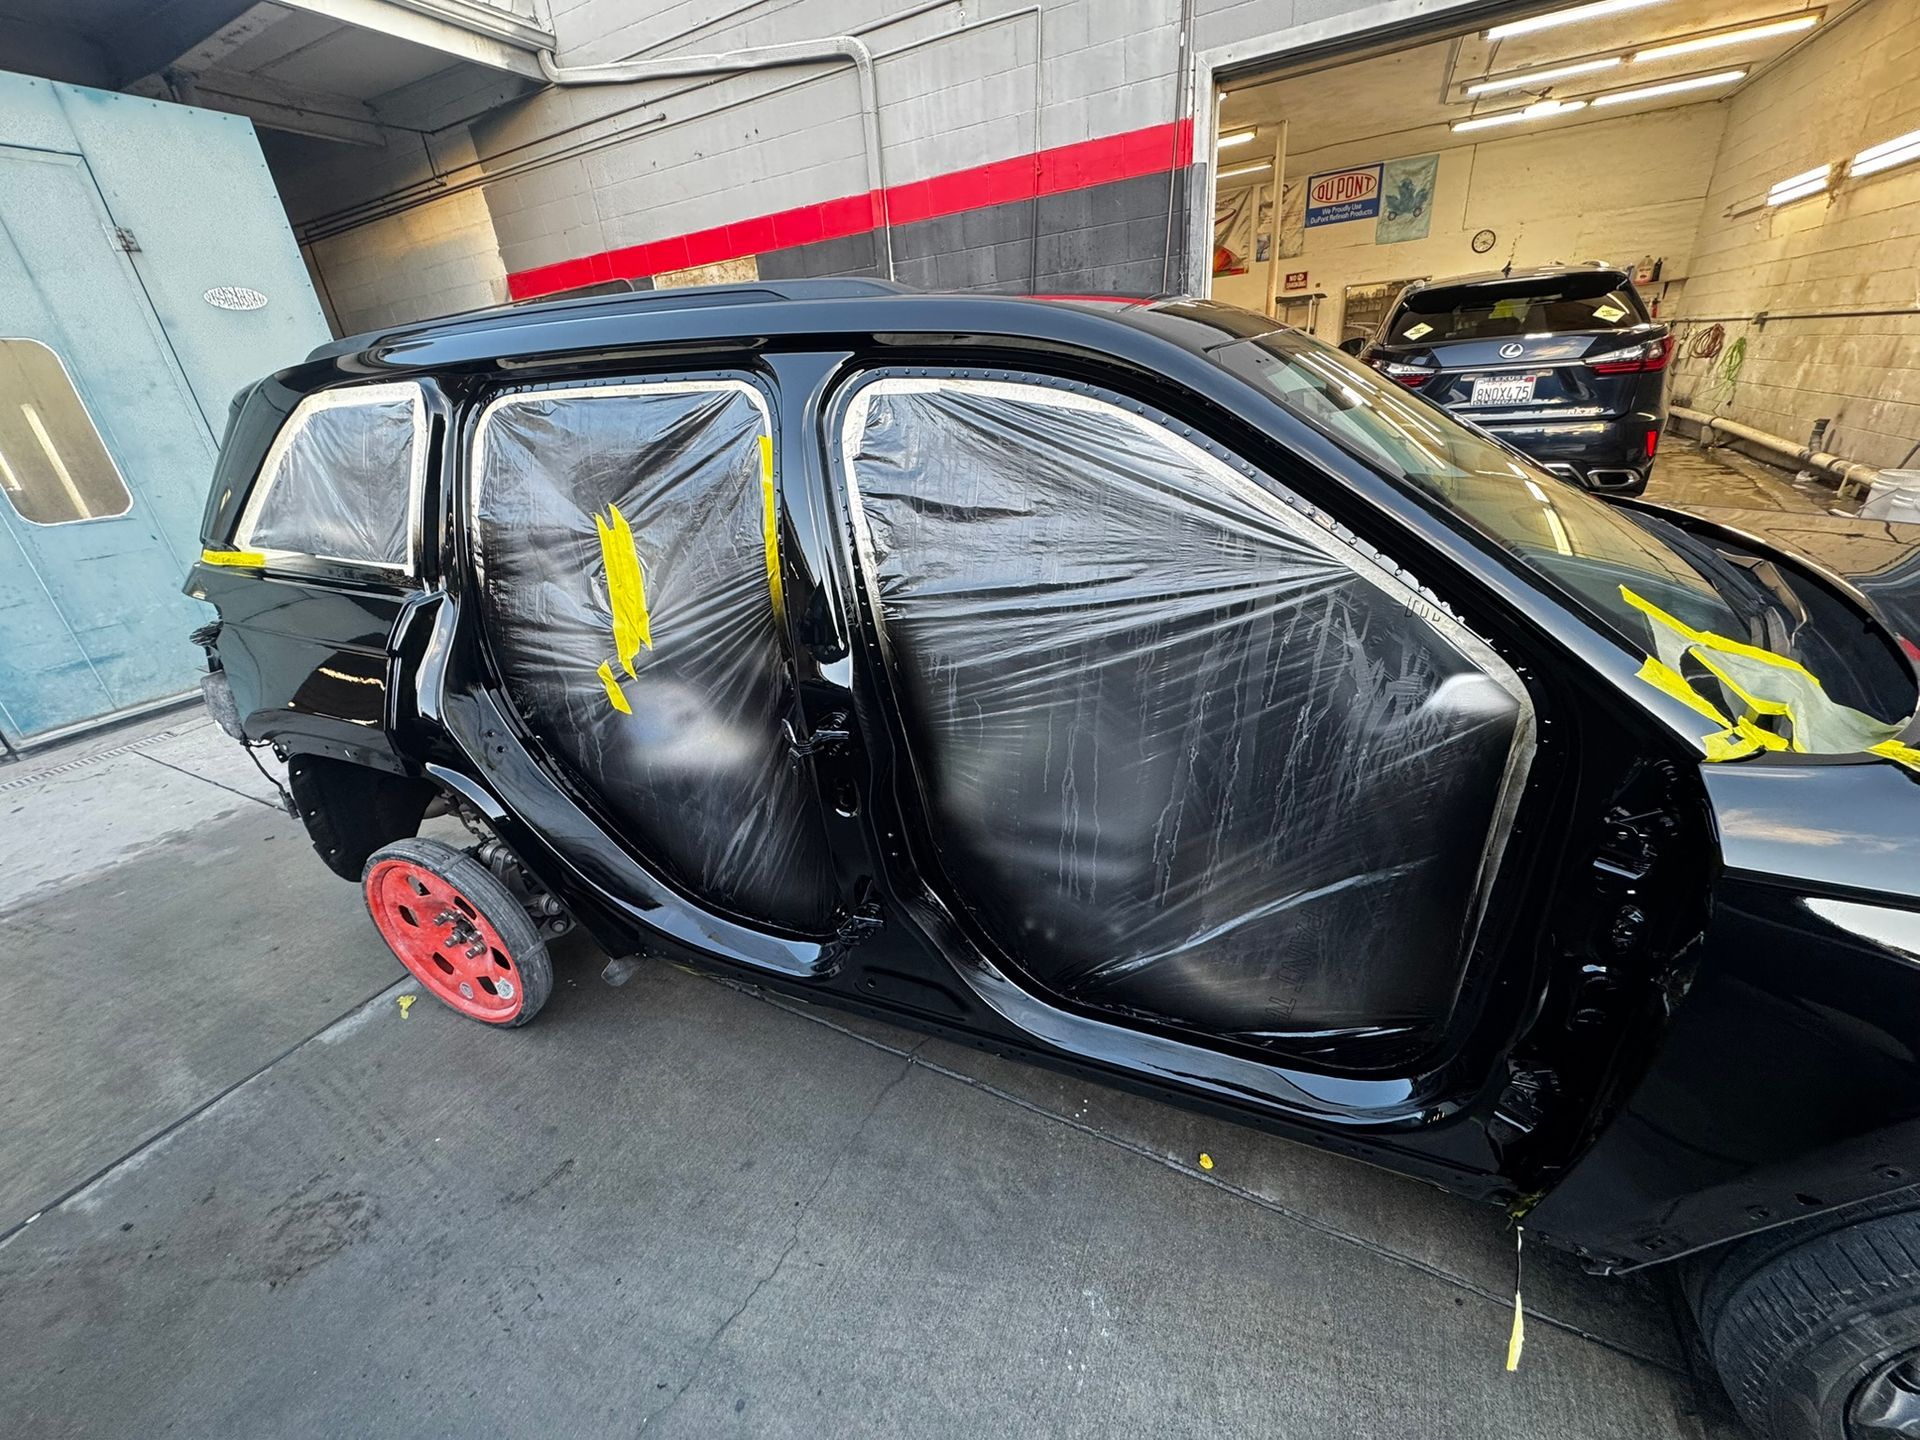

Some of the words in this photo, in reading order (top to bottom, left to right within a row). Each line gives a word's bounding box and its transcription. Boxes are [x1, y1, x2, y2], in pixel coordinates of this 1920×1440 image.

[1310, 215, 1329, 225] DuPont
[1350, 208, 1373, 217] Products
[1322, 207, 1331, 215] We
[1332, 204, 1351, 214] Proudly
